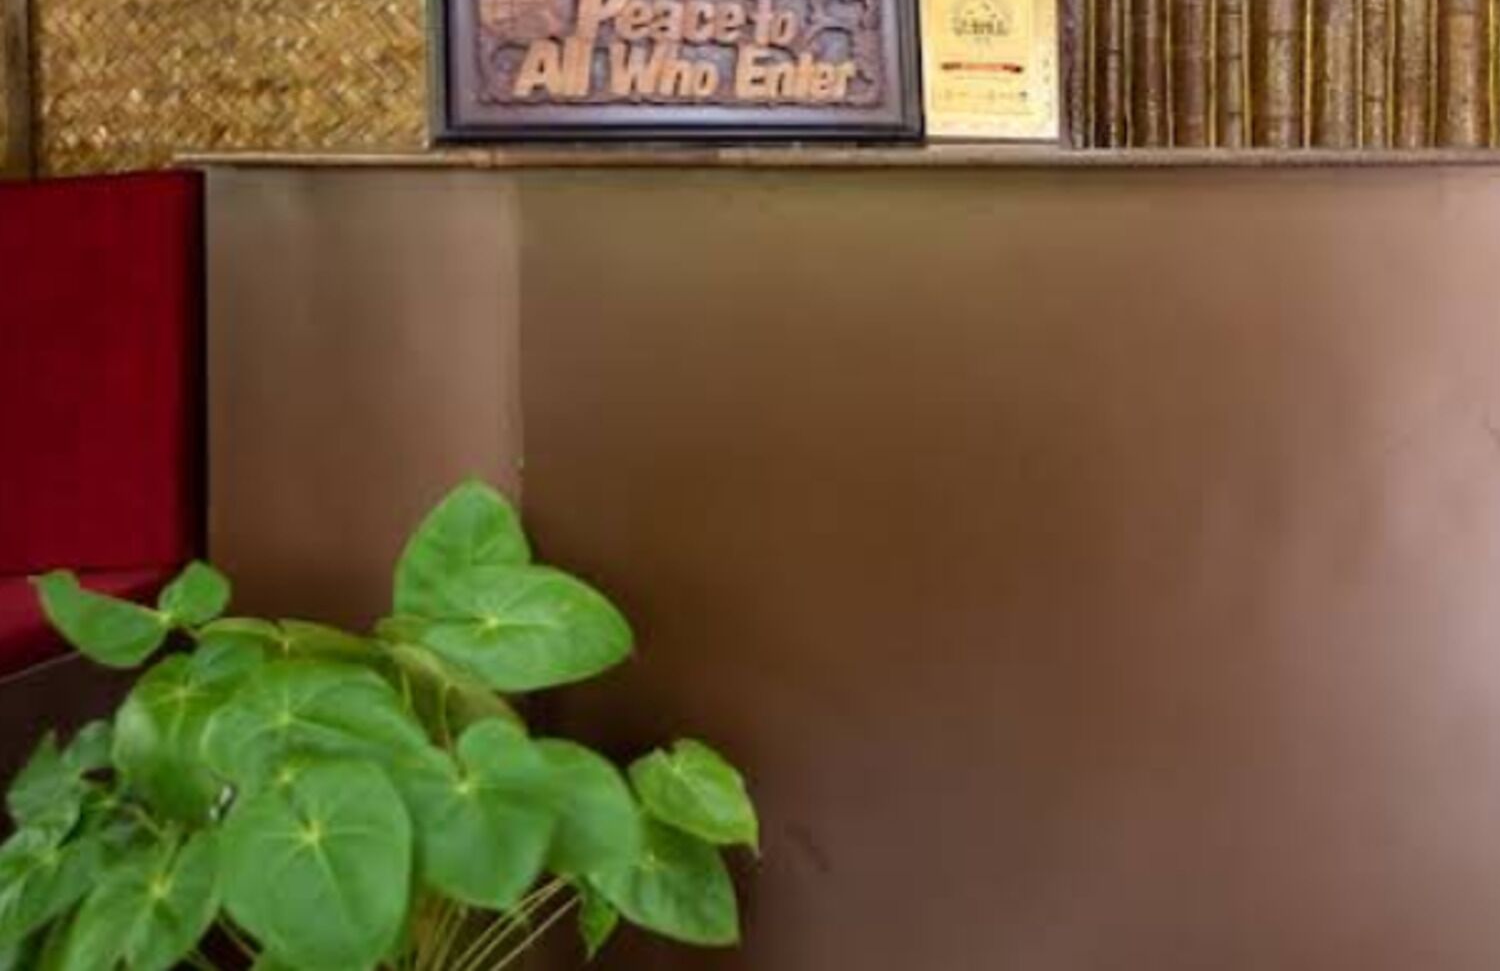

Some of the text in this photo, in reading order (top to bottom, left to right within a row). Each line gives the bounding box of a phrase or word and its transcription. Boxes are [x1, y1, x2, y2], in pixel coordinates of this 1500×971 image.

[513, 36, 855, 99] All Who Enter
